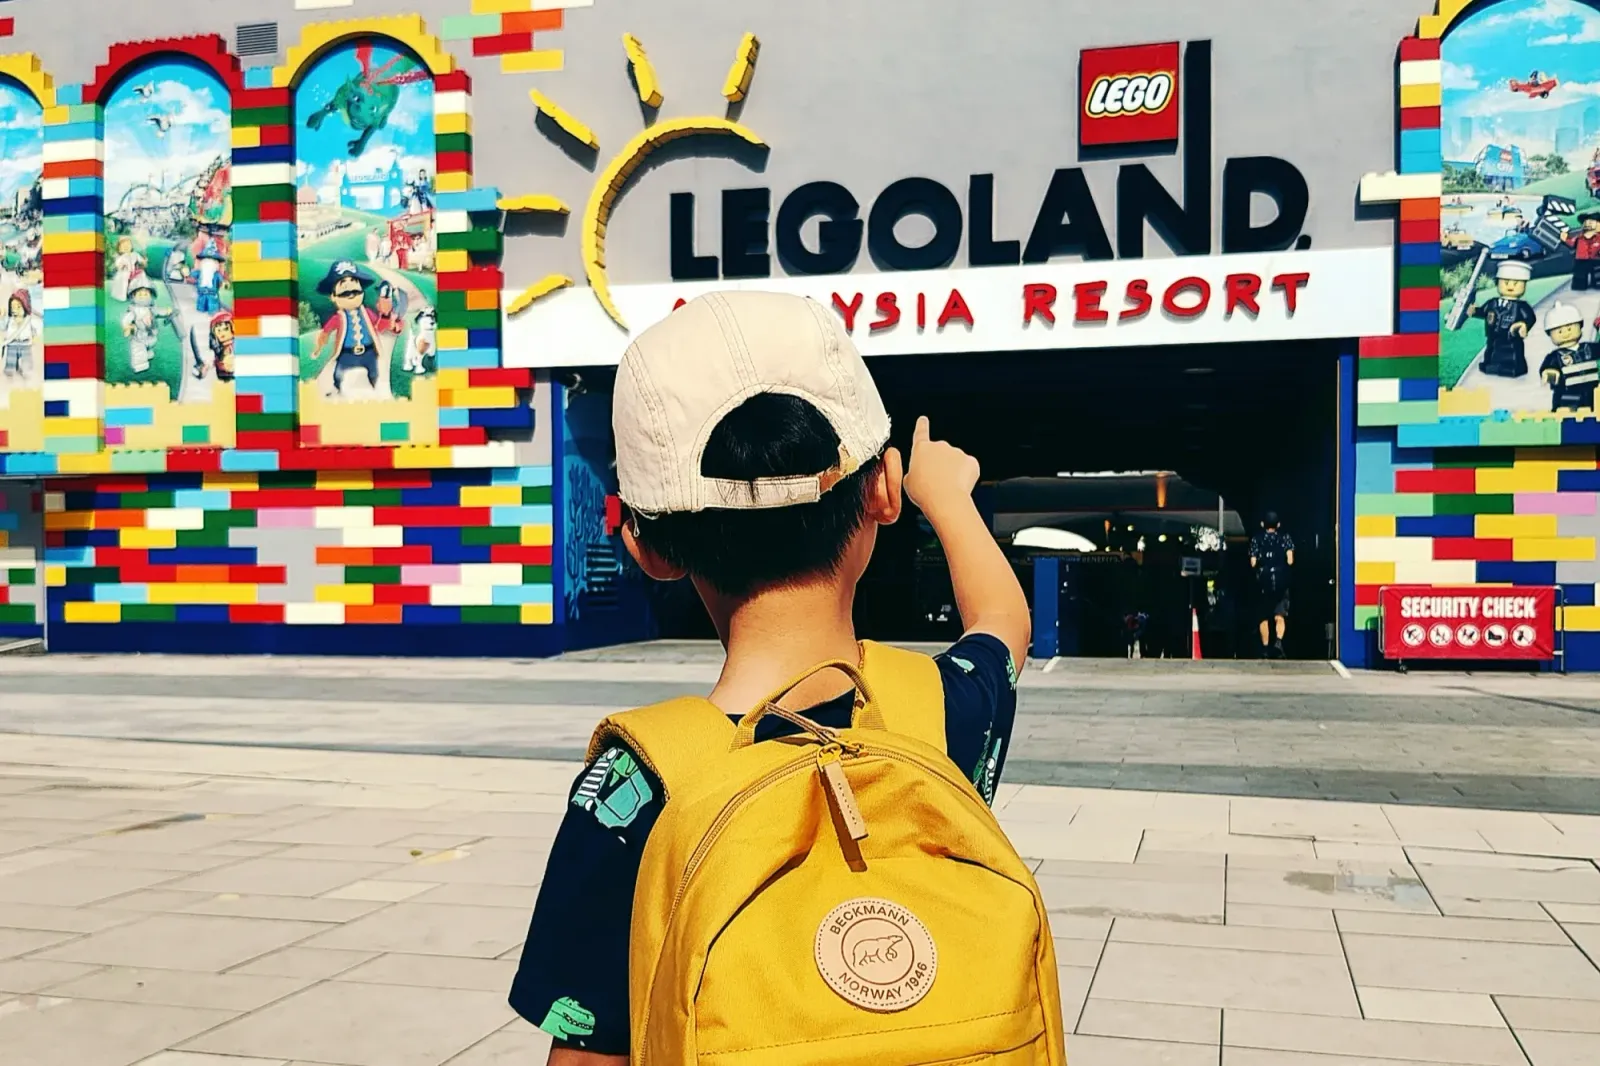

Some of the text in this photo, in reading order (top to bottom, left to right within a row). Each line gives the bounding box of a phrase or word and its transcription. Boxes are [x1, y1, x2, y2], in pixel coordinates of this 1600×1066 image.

[1087, 73, 1172, 116] LEGO
[1022, 272, 1310, 329] RESORT
[1400, 596, 1536, 618] SECURITY CHECK
[829, 904, 909, 935] BECKMANN
[839, 961, 928, 1000] NORWAY 1946
